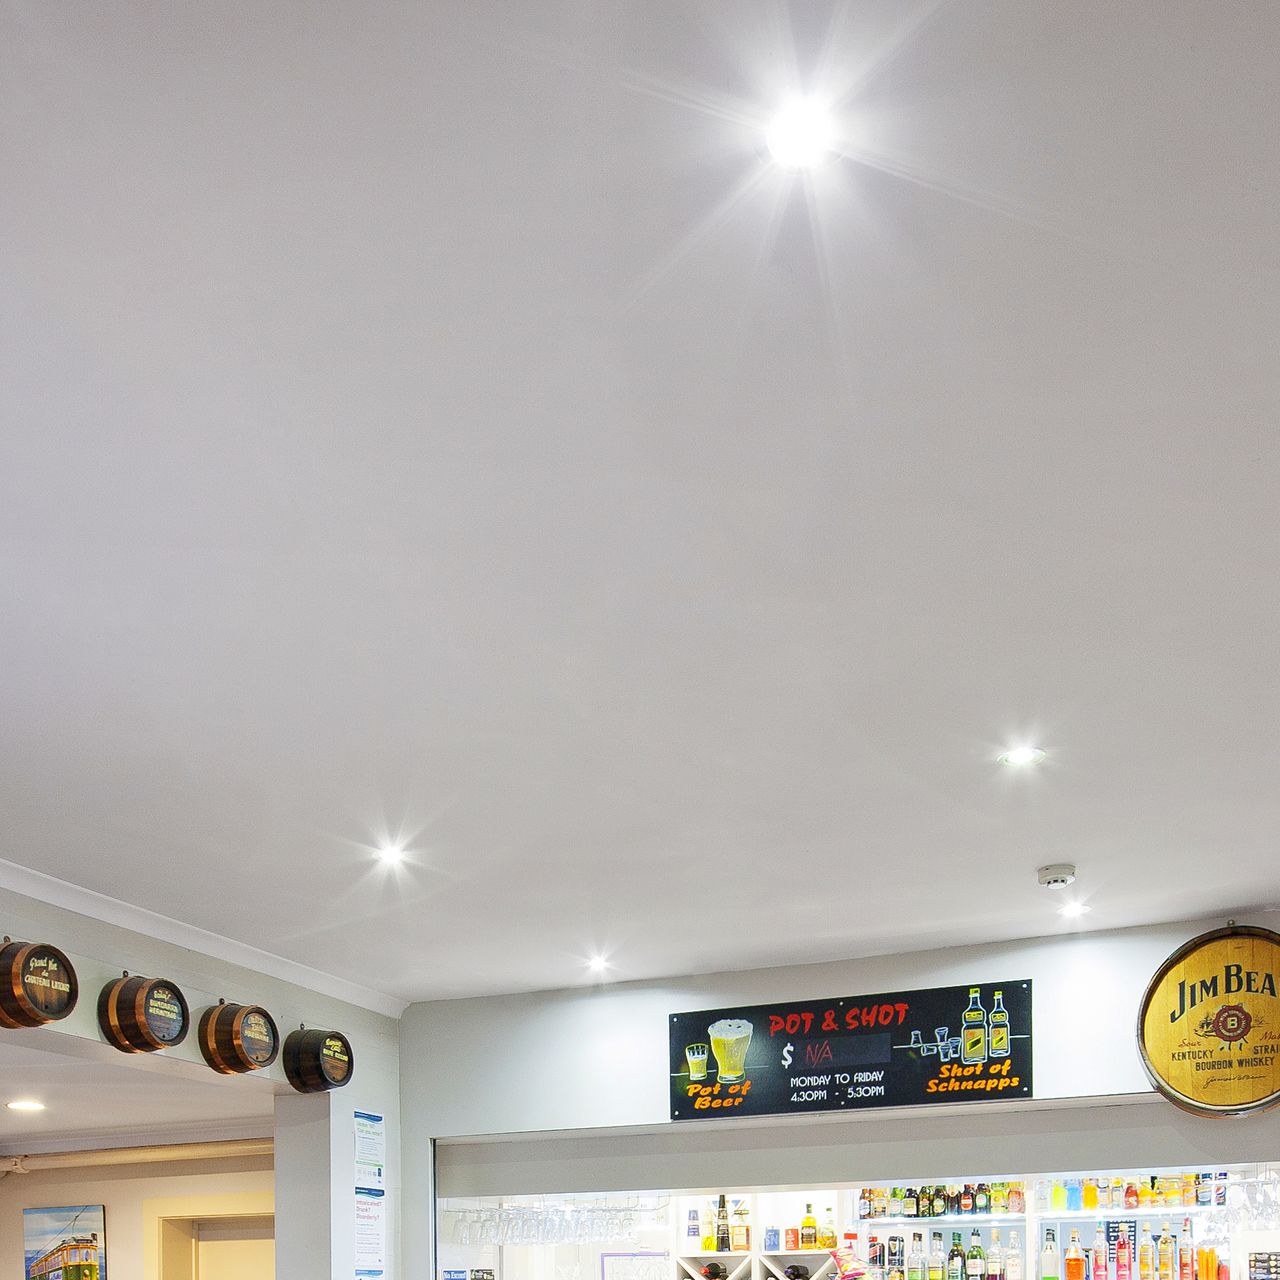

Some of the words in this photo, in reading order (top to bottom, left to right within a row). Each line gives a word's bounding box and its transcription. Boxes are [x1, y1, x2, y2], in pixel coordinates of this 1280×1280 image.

[1170, 975, 1218, 1023] JIM
[769, 1013, 813, 1037] POT
[821, 1011, 840, 1030] &
[846, 1003, 911, 1028] SHOT
[781, 1043, 795, 1069] $
[805, 1040, 833, 1069] N/A
[1172, 1049, 1214, 1061] KENTUCKY
[939, 1061, 983, 1078] Shot
[989, 1059, 1012, 1076] of
[1195, 1060, 1233, 1071] BOURBON
[1237, 1056, 1275, 1068] WHISKEY
[790, 1075, 832, 1088] MONDAY
[834, 1073, 850, 1085] TO
[853, 1071, 885, 1084] FRIDAY
[926, 1075, 1020, 1093] Schnapps
[687, 1083, 724, 1097] Pot
[729, 1081, 754, 1095] of
[693, 1096, 743, 1109] Beer
